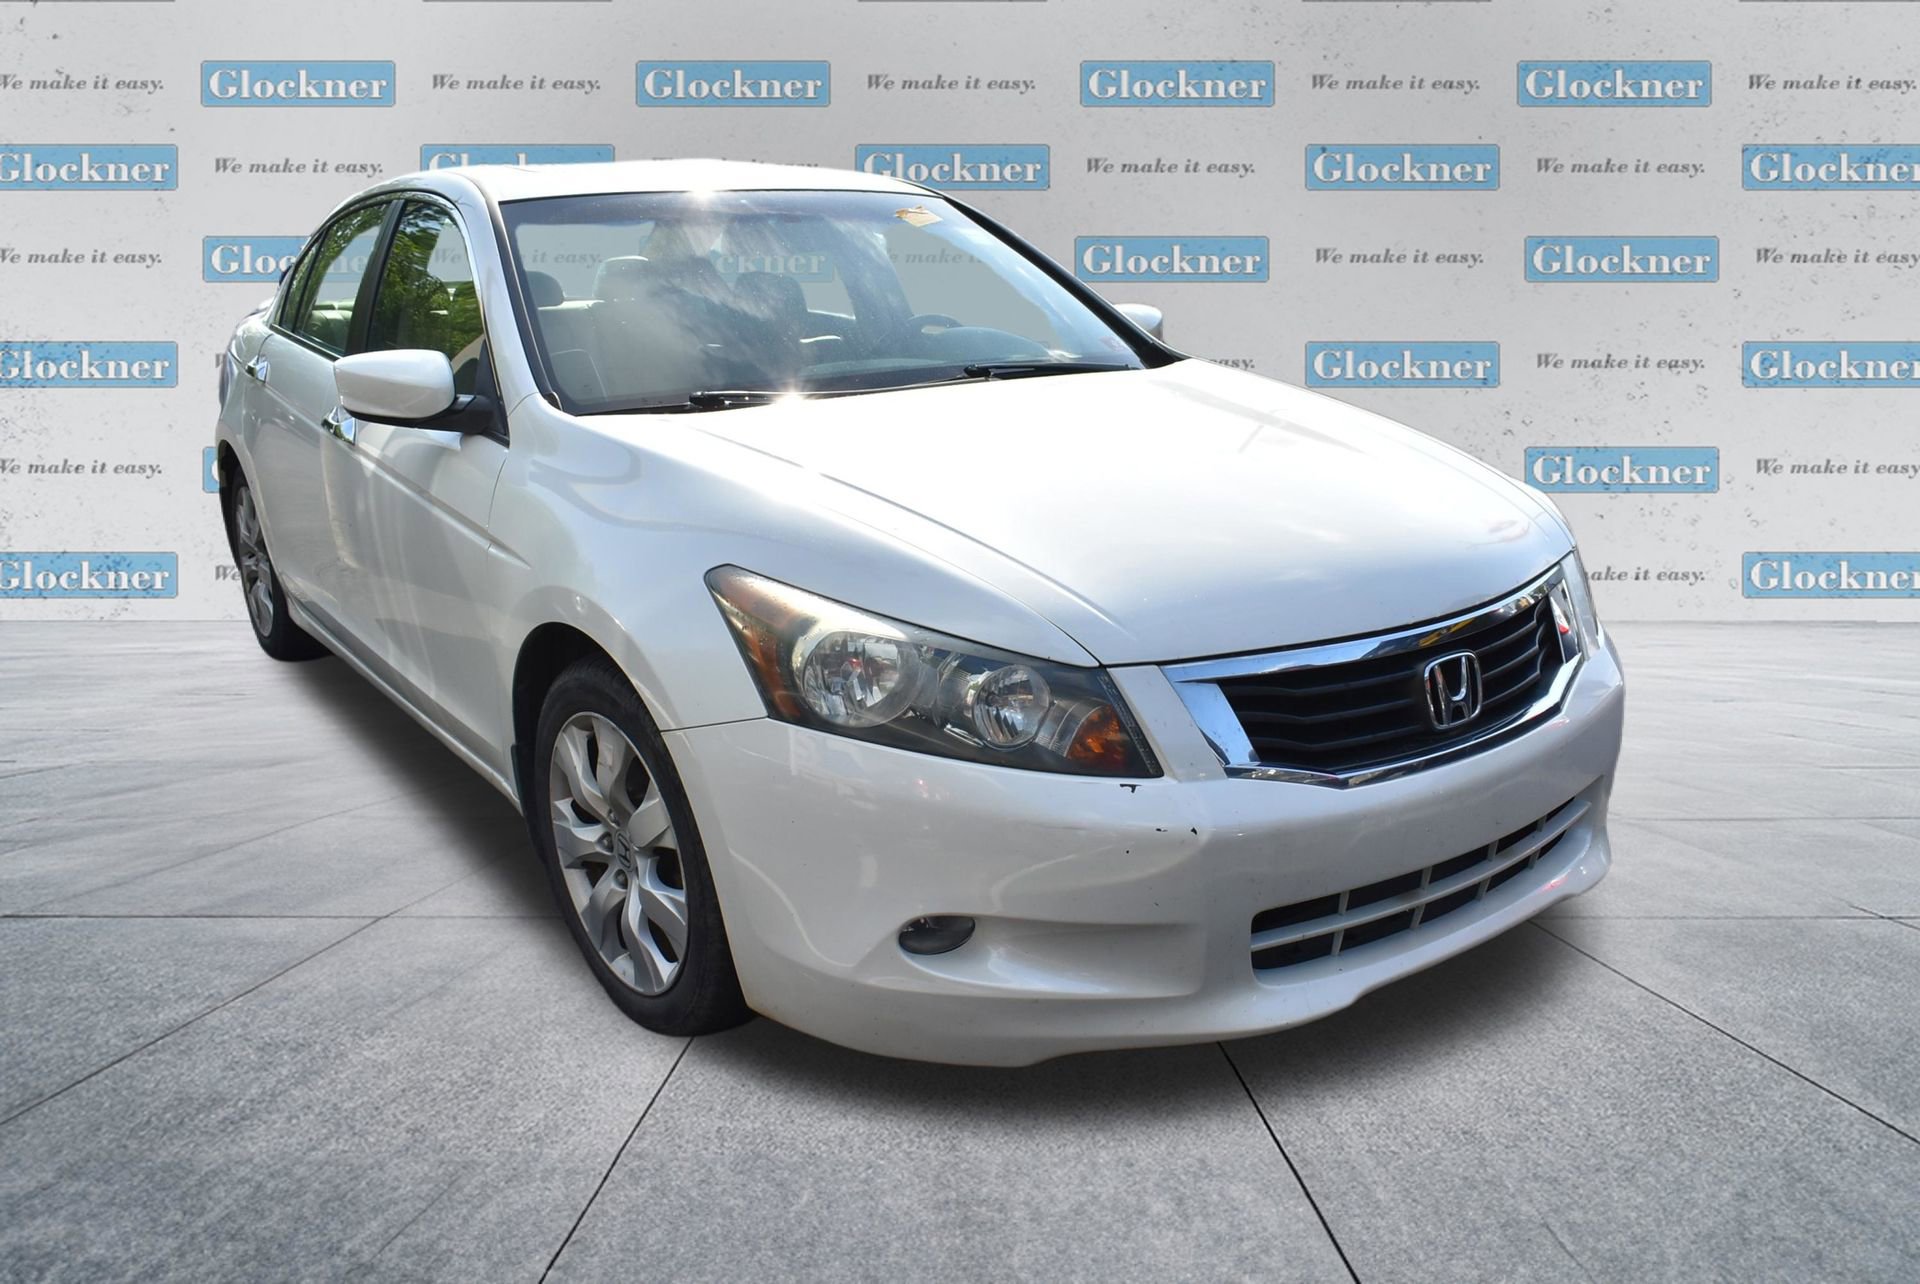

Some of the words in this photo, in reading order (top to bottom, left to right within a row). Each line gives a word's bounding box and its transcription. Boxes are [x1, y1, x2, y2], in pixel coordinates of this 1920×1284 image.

[29, 74, 87, 90] make
[93, 75, 110, 90] it
[115, 79, 164, 95] easy.
[209, 69, 387, 99] Glockner
[432, 74, 460, 90] We
[466, 74, 524, 90] make
[530, 75, 547, 90] it
[552, 79, 601, 95] easy.
[644, 69, 822, 99] Glockner
[867, 74, 895, 90] We
[901, 74, 959, 90] make
[965, 75, 982, 90] it
[987, 79, 1036, 95] easy.
[1088, 69, 1266, 99] Glockner
[1311, 74, 1339, 90] We
[1345, 74, 1403, 90] make
[1409, 75, 1426, 90] it
[1431, 79, 1480, 95] easy.
[1525, 69, 1703, 99] Glockner
[1748, 74, 1776, 90] We
[1782, 74, 1840, 90] make
[1846, 75, 1863, 90] it
[1868, 79, 1917, 95] easy.
[0, 153, 170, 183] Glockner
[214, 158, 242, 174] We
[248, 158, 306, 174] make
[312, 159, 329, 174] it
[334, 163, 383, 179] easy.
[863, 153, 1041, 183] Glockner
[1086, 158, 1114, 174] We
[1120, 158, 1178, 174] make
[1184, 159, 1201, 174] it
[1206, 163, 1255, 179] easy.
[1313, 153, 1491, 183] Glockner
[1536, 158, 1564, 174] We
[1570, 158, 1628, 174] make
[1634, 159, 1651, 174] it
[1656, 163, 1705, 179] easy.
[27, 248, 85, 264] make
[91, 249, 108, 264] it
[113, 253, 162, 269] easy.
[532, 249, 548, 264] it
[905, 248, 963, 264] make
[1083, 245, 1261, 275] Glockner
[1315, 248, 1343, 264] We
[1349, 248, 1407, 264] make
[1413, 249, 1430, 264] it
[1435, 253, 1484, 269] easy.
[1533, 245, 1711, 275] Glockner
[1755, 248, 1783, 264] We
[1789, 248, 1847, 264] make
[1853, 249, 1870, 264] it
[0, 350, 170, 380] Glockner
[1313, 350, 1491, 380] Glockner
[1536, 353, 1564, 369] We
[1570, 353, 1628, 369] make
[1634, 354, 1651, 369] it
[1656, 358, 1705, 374] easy.
[27, 458, 85, 474] make
[91, 459, 108, 474] it
[113, 463, 162, 479] easy.
[1533, 455, 1711, 485] Glockner
[1756, 458, 1784, 474] We
[1790, 458, 1848, 474] make
[1854, 459, 1871, 474] it
[0, 560, 169, 590] Glockner
[1634, 567, 1651, 581] it
[1656, 570, 1705, 586] easy.
